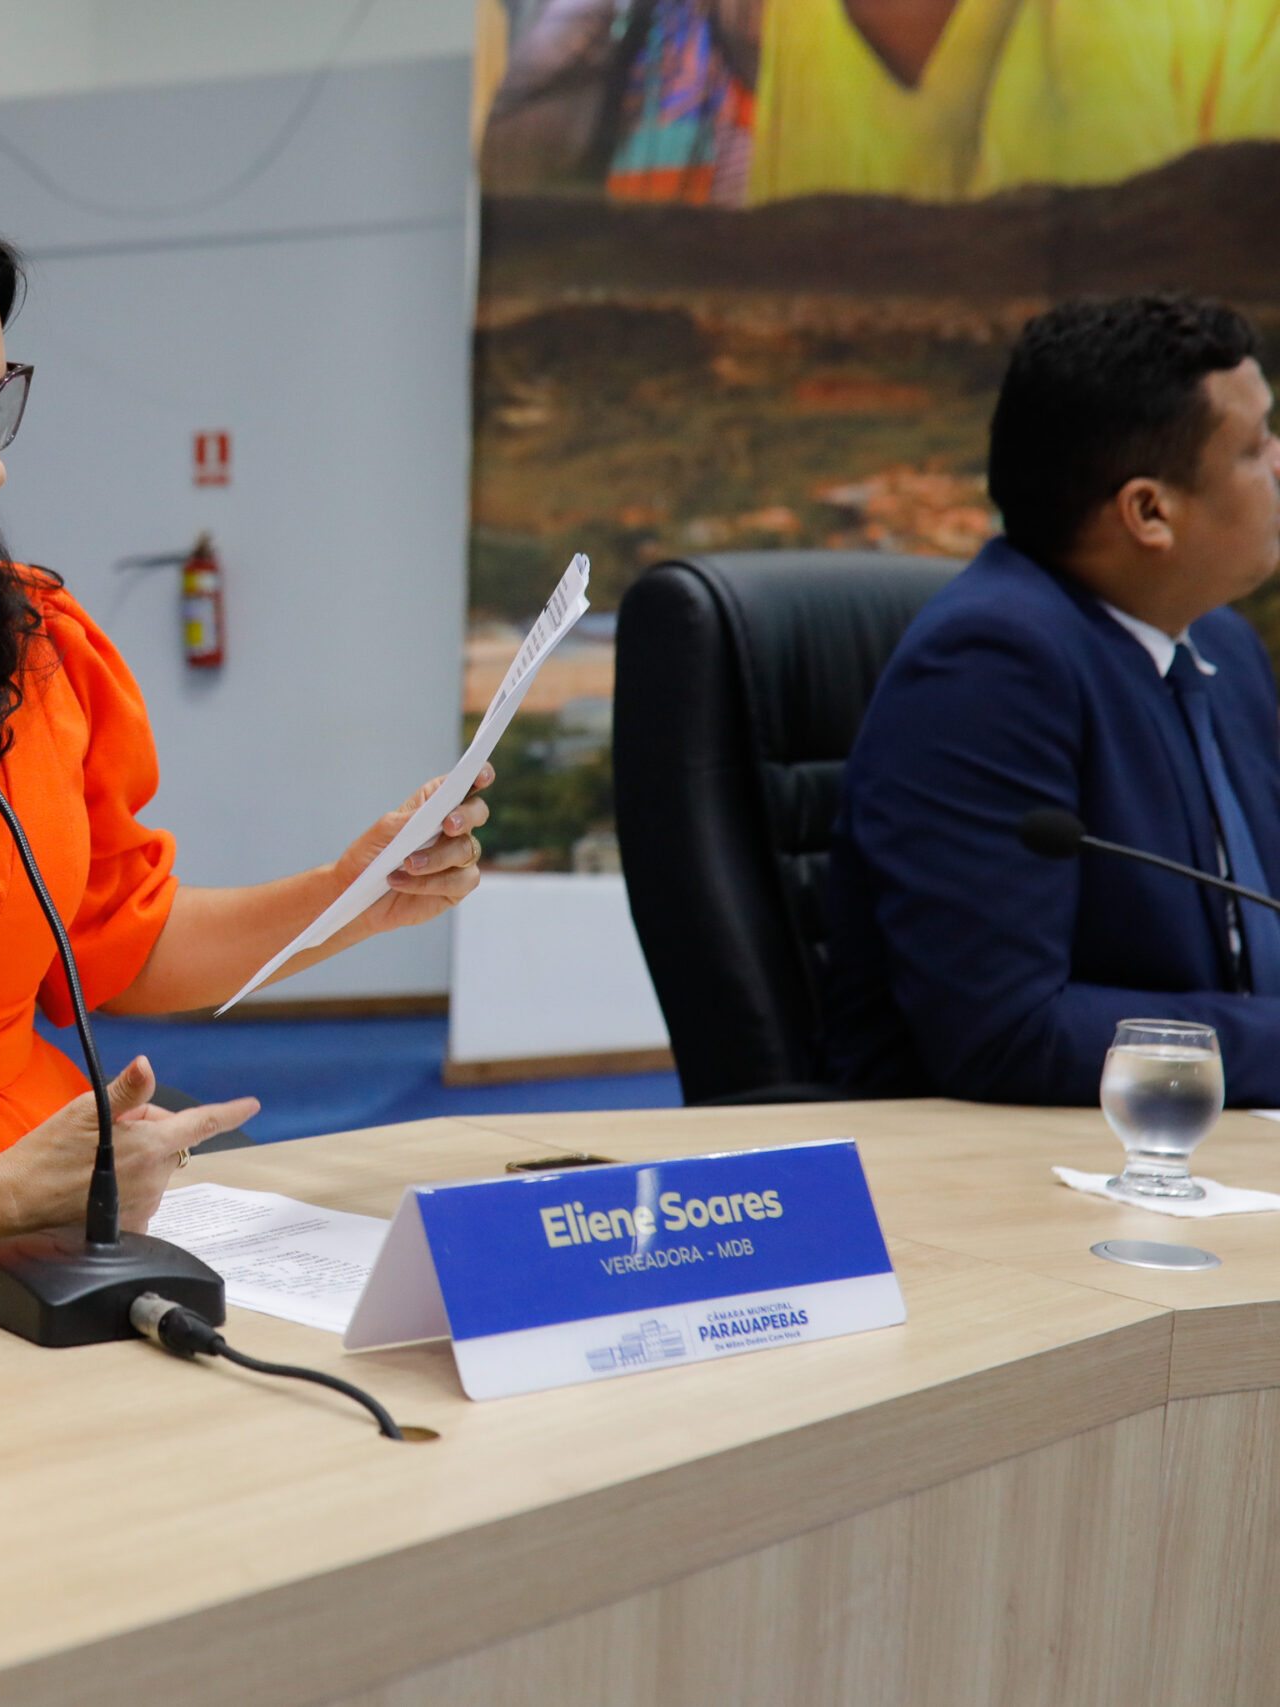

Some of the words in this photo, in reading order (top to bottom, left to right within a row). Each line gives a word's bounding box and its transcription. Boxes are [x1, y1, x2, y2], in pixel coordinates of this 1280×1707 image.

[540, 1201, 657, 1248] Eliene
[659, 1190, 783, 1231] Soares
[600, 1245, 704, 1276] VEREADORA
[716, 1238, 755, 1259] MDB
[699, 1310, 808, 1341] PARAUAPEBAS
[747, 1302, 792, 1315] MUNICIPAL
